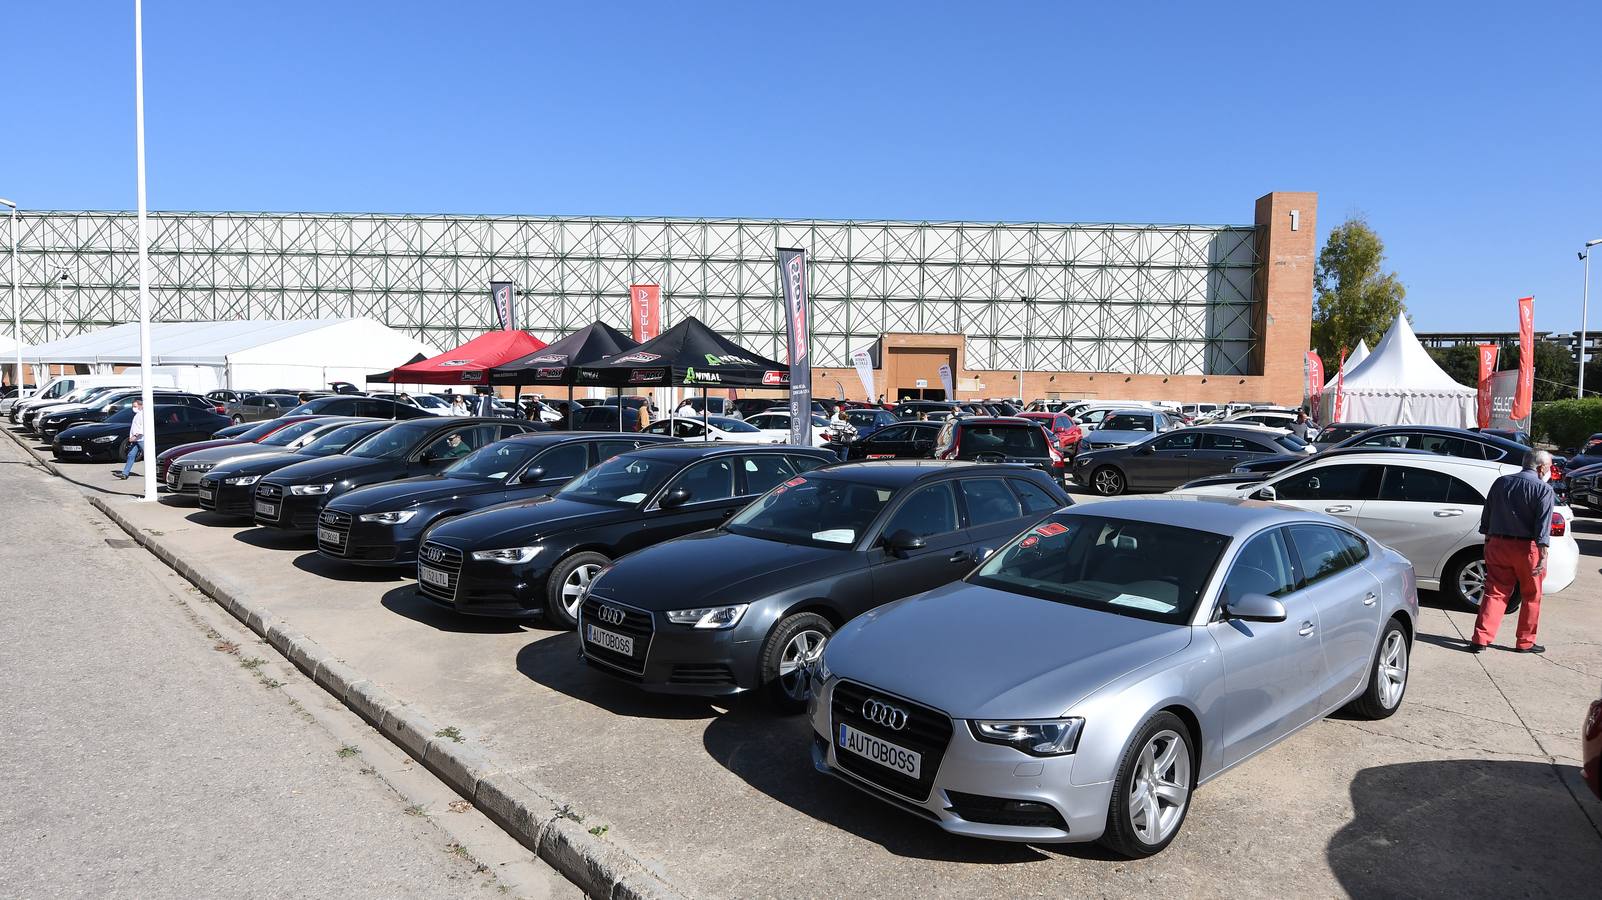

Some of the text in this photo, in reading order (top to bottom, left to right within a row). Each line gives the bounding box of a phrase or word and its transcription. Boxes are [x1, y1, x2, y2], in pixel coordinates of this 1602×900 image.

[1289, 209, 1299, 231] 1
[683, 367, 721, 384] ANIMAL
[593, 627, 630, 653] AUTOBOSS
[848, 731, 915, 772] AUTOBOSS
